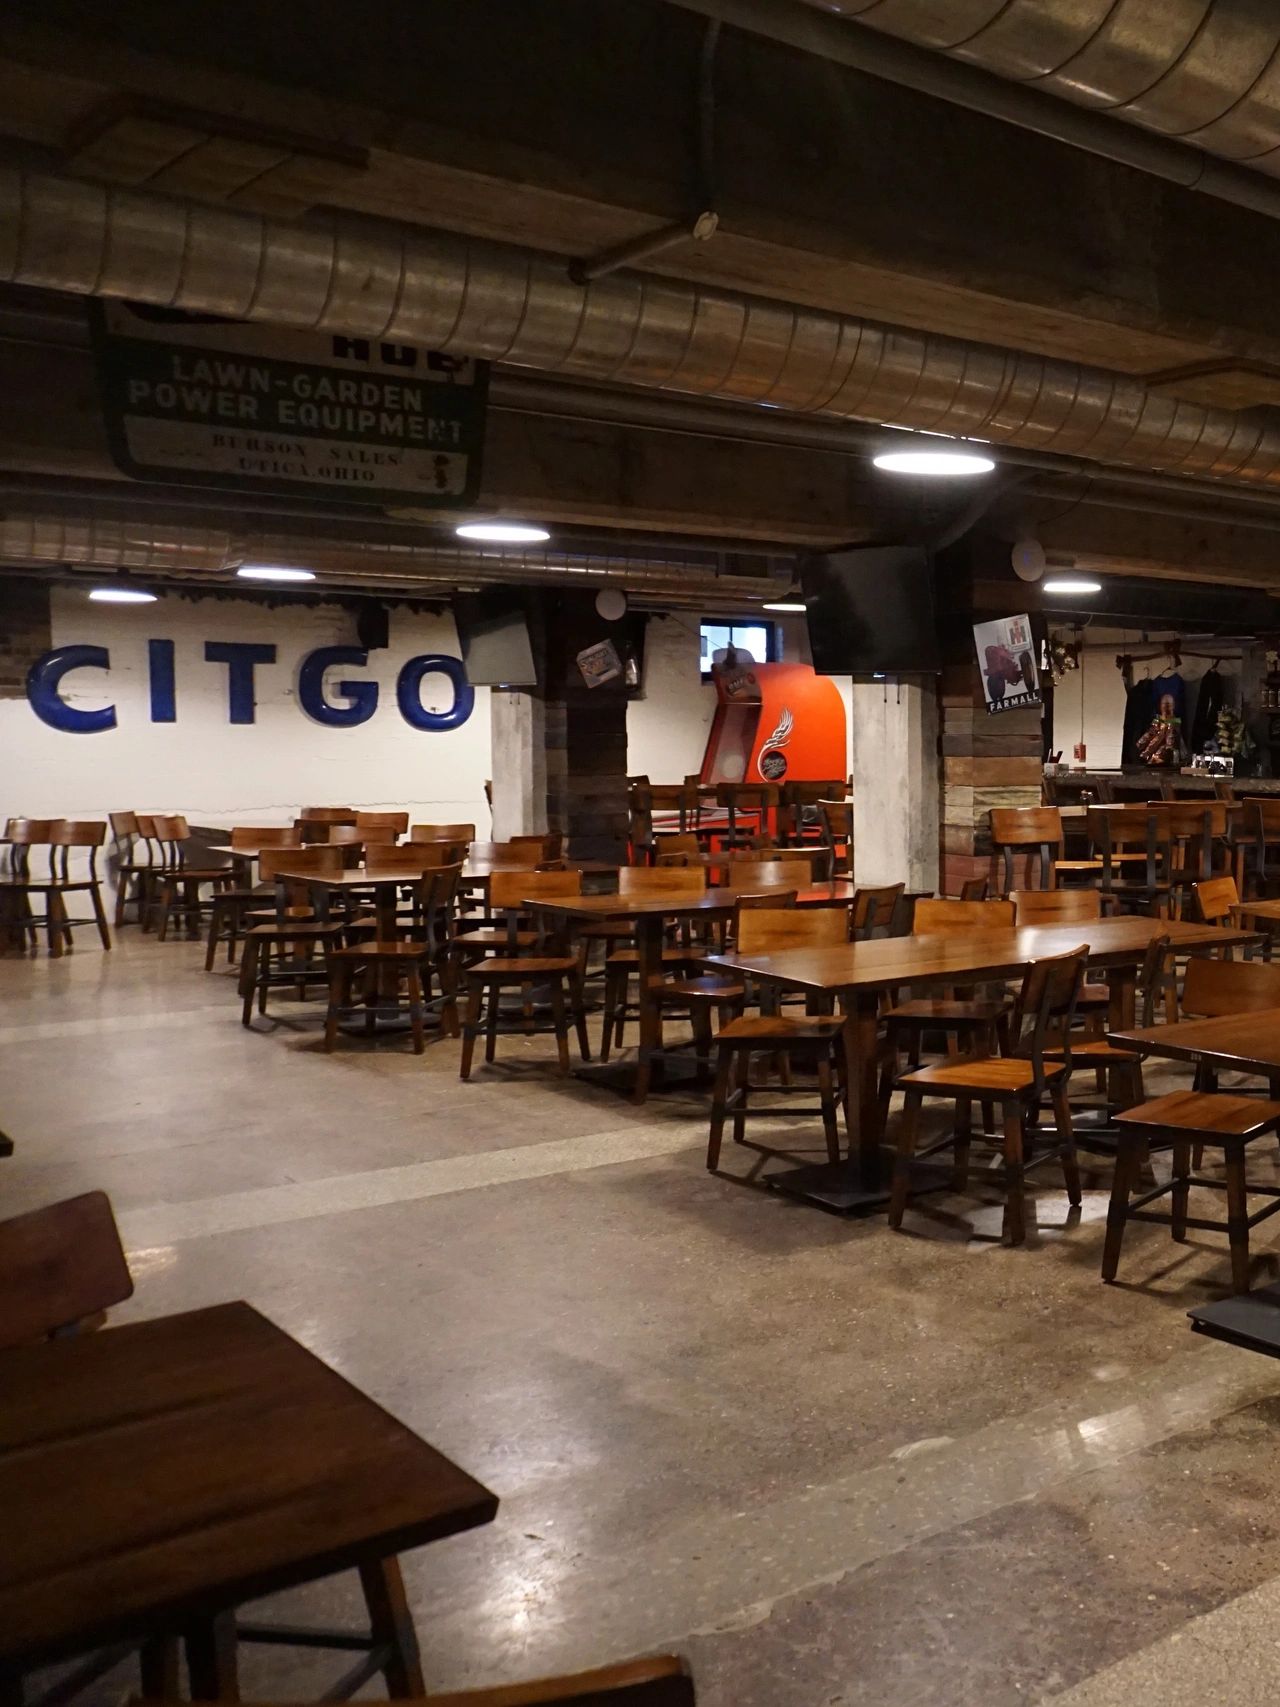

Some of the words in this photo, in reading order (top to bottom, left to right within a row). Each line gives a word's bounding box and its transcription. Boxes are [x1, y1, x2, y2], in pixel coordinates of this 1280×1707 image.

[129, 378, 259, 420] POWER
[278, 399, 462, 444] EQUIPMENT
[173, 354, 423, 412] LAWN-GARDEN
[330, 448, 399, 466] SALES
[26, 639, 476, 734] CITGO
[990, 692, 1039, 712] FARMALL
